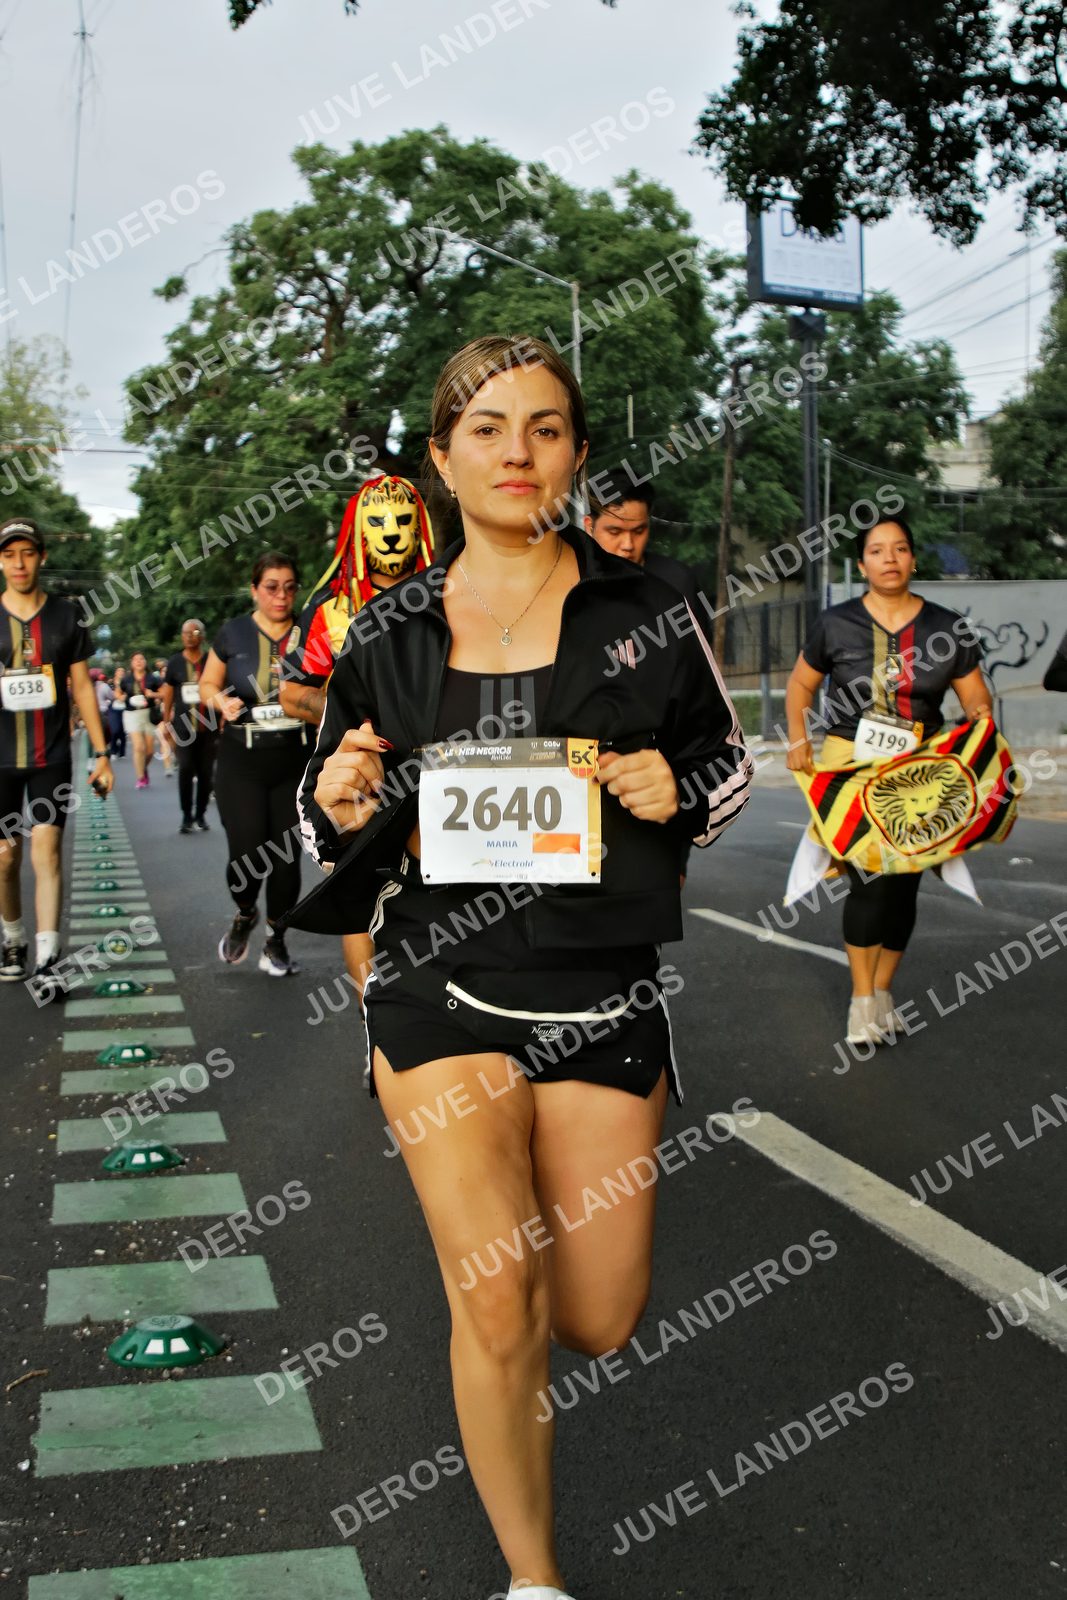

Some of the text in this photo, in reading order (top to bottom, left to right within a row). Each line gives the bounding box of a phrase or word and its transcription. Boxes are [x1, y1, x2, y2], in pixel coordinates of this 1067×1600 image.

[9, 680, 44, 696] 6538
[864, 728, 908, 752] 2199
[476, 746, 512, 756] NEGROS
[442, 786, 562, 831] 2640
[486, 840, 518, 848] MARIA
